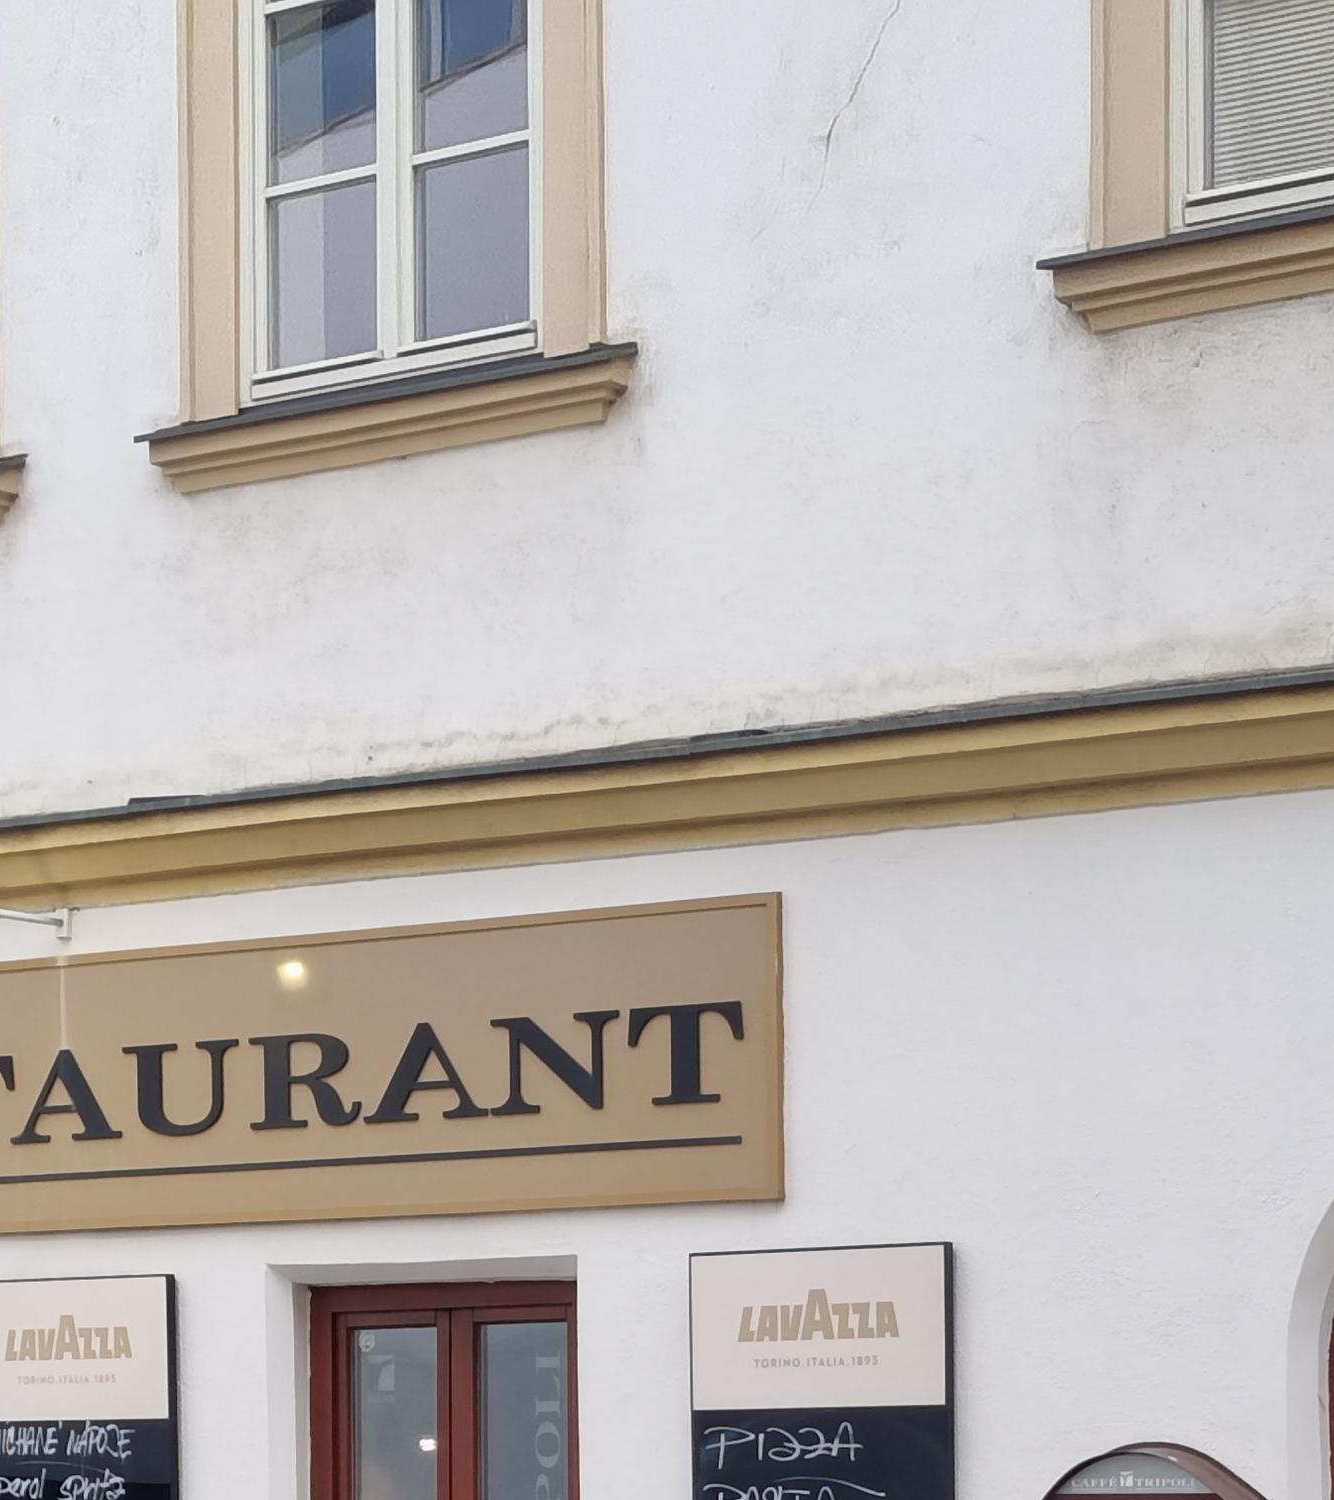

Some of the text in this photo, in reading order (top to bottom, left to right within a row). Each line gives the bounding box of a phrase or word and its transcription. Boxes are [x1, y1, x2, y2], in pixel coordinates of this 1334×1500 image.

[4, 1314, 132, 1361] LAVAZZA
[737, 1288, 900, 1342] LAVAZZA
[703, 1422, 864, 1470] PIZZA
[1134, 1478, 1194, 1488] TRIPOLI
